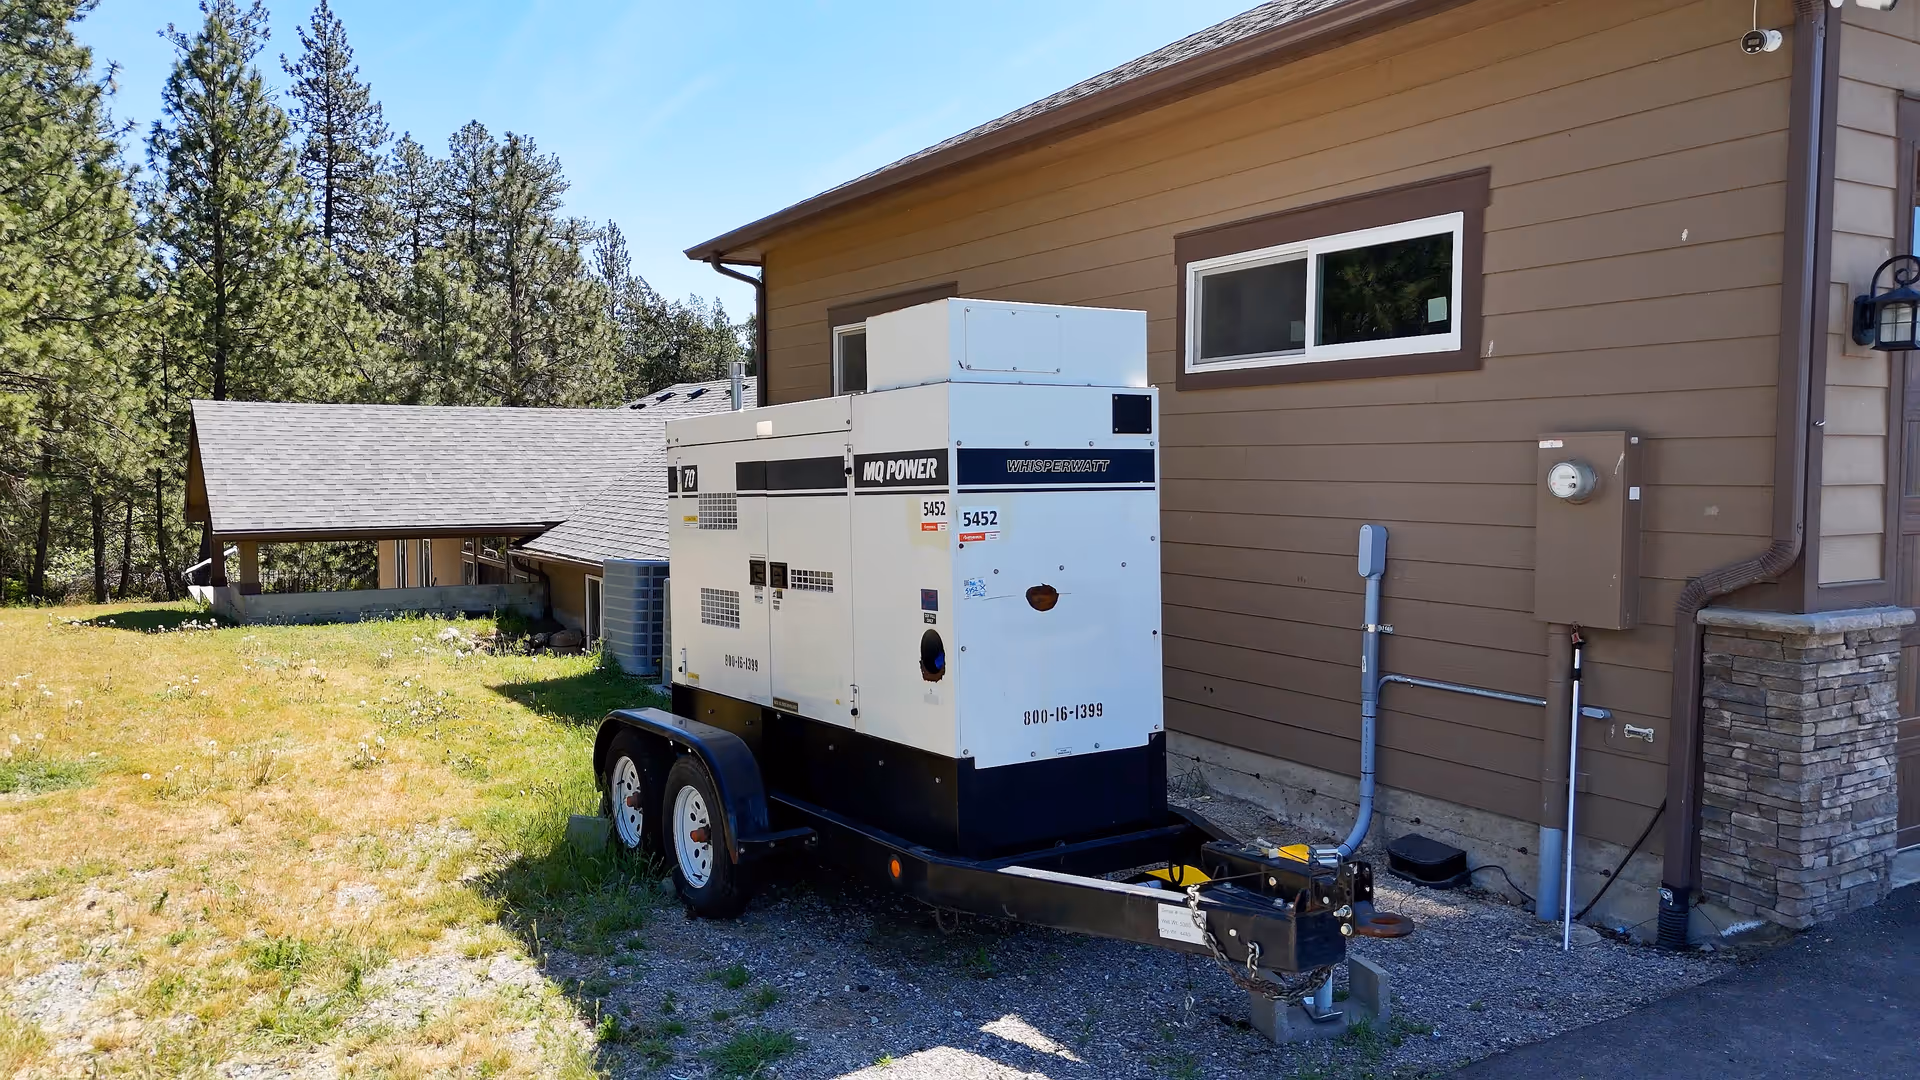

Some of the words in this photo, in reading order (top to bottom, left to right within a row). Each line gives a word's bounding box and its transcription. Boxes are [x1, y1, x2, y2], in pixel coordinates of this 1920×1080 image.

[863, 461, 884, 483] MQ
[886, 458, 937, 480] POWER
[1007, 459, 1110, 472] WHISPERWATT
[684, 469, 695, 488] 70
[923, 501, 946, 516] 5452
[963, 510, 998, 527] 5452
[724, 654, 759, 672] 800-16-1399
[1023, 702, 1103, 726] 800-16-1399
